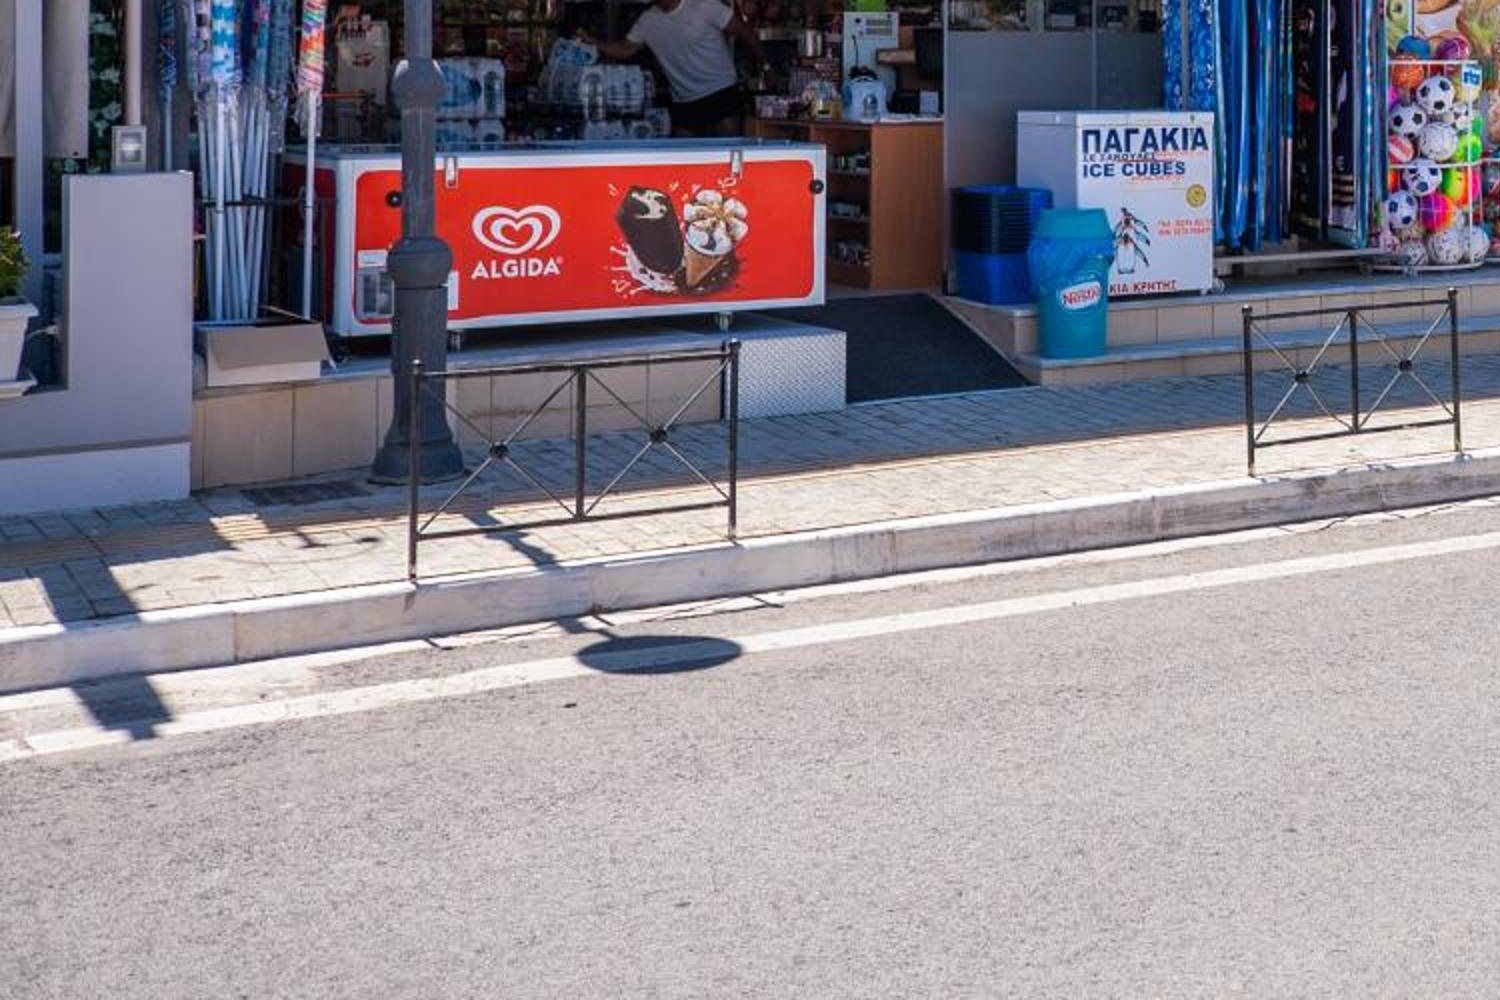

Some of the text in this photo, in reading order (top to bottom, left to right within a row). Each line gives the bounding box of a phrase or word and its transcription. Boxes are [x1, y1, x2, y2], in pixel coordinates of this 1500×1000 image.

[1081, 126, 1209, 154] ΠΑΓΑΚΙΑ
[1083, 161, 1186, 178] ICE CUBES
[471, 256, 561, 280] ALGIDA
